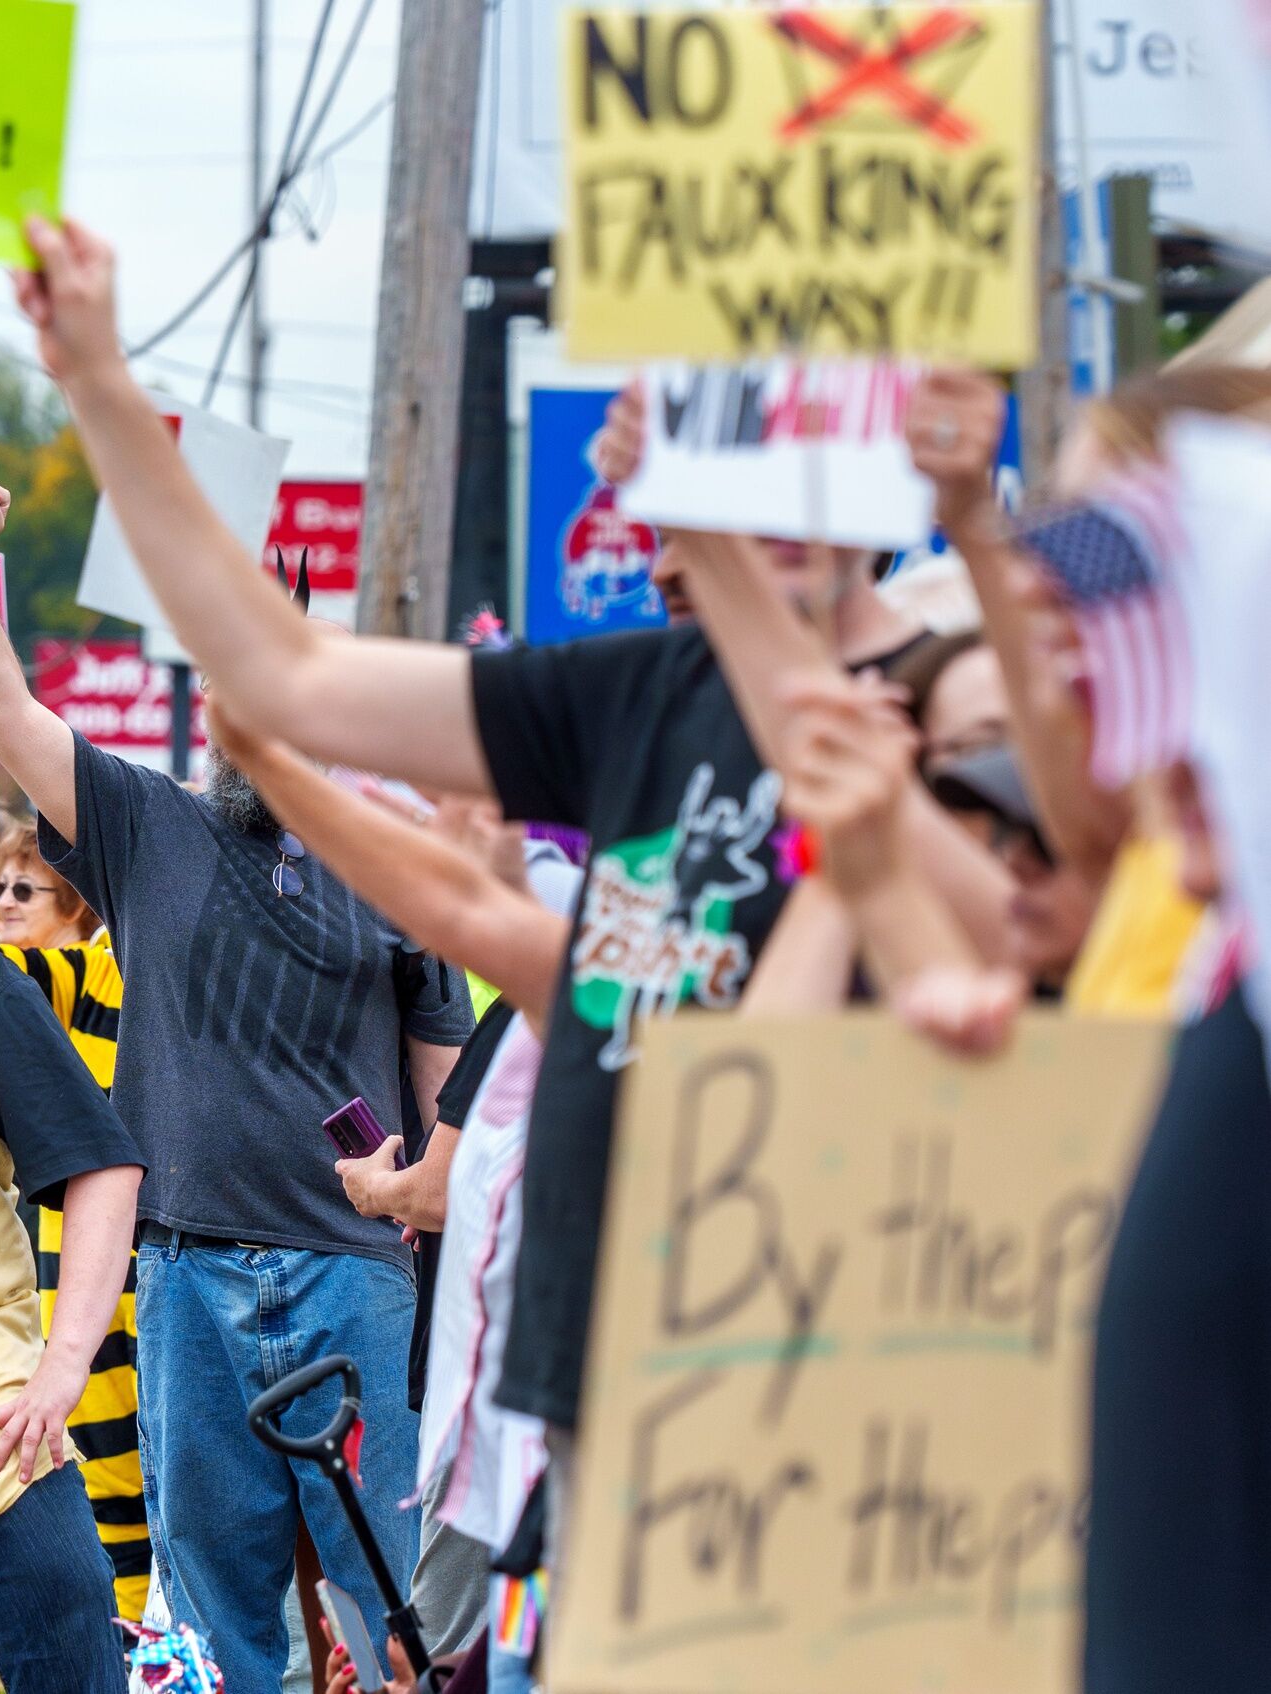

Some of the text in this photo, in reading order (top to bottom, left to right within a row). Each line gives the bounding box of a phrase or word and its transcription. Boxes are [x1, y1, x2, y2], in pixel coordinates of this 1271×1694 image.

[580, 12, 733, 135] NO
[578, 142, 1015, 292] FAUX KING
[660, 1047, 845, 1435] By
[615, 1370, 815, 1628] For
